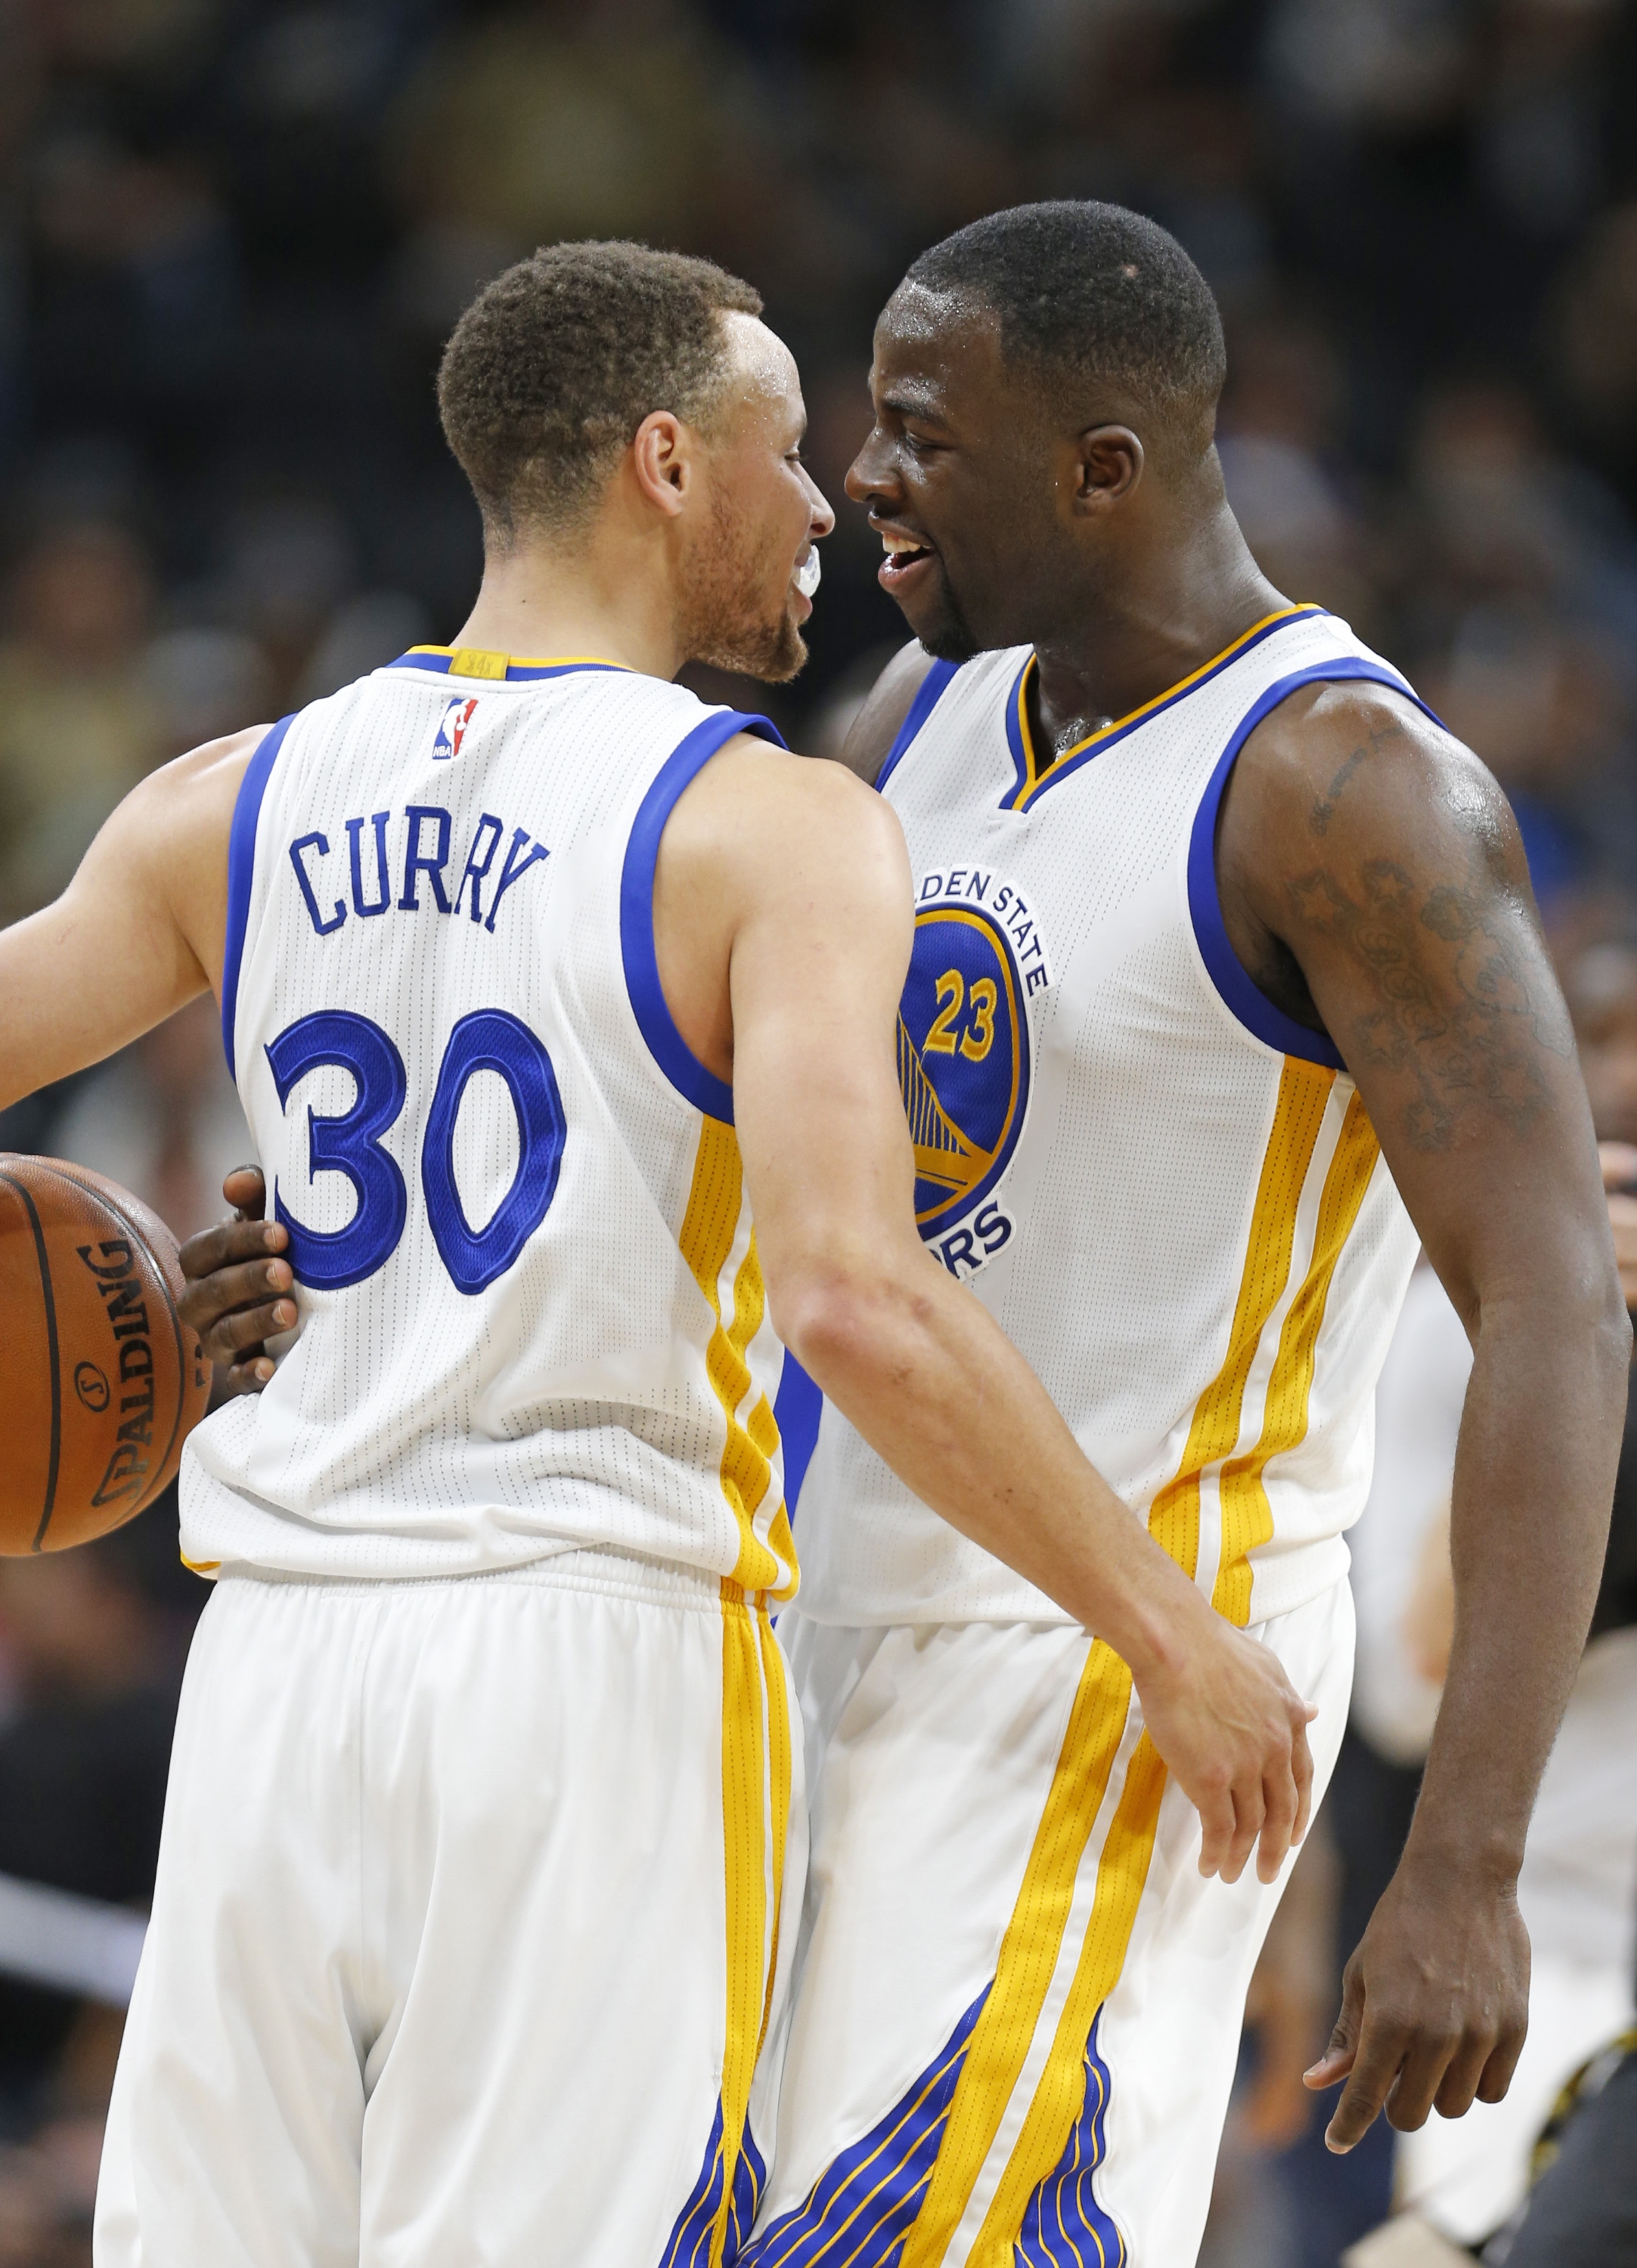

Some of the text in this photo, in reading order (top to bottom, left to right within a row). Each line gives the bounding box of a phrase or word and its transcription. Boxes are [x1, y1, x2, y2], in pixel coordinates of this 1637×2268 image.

[433, 745, 451, 758] NBA
[289, 804, 550, 936] CURRY
[914, 870, 1049, 997] DEN STATE
[922, 968, 997, 1063] 23
[264, 1009, 568, 1295] 30
[929, 1200, 1012, 1279] RS
[76, 1239, 153, 1507] SPALDING
